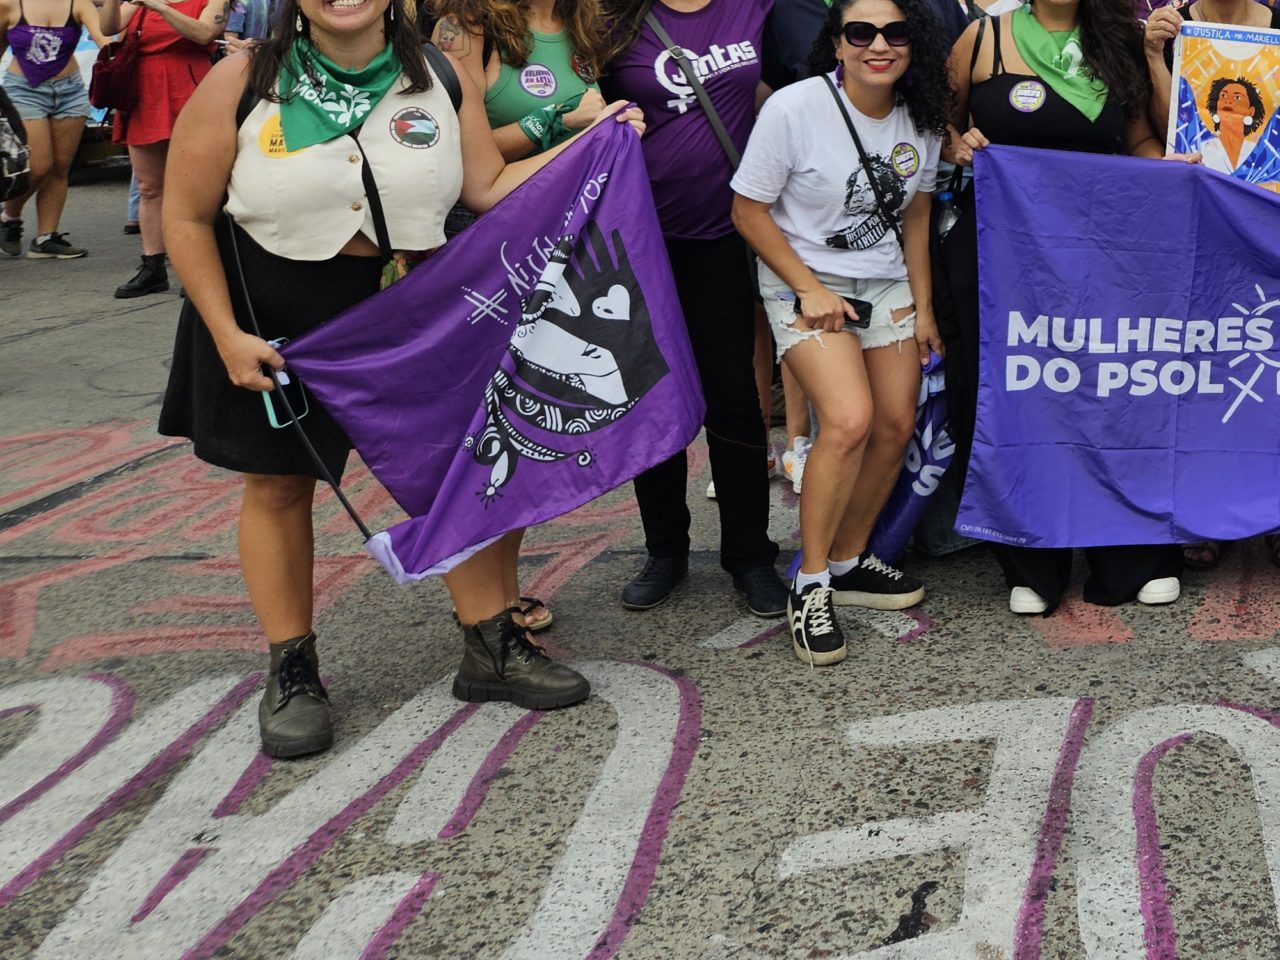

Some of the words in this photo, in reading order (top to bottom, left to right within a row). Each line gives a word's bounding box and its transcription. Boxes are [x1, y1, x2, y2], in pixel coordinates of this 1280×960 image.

[1193, 26, 1231, 40] JUSTIÇA
[1006, 310, 1275, 355] MULHERES
[1004, 354, 1082, 393] DO
[1096, 359, 1225, 399] PSOL
